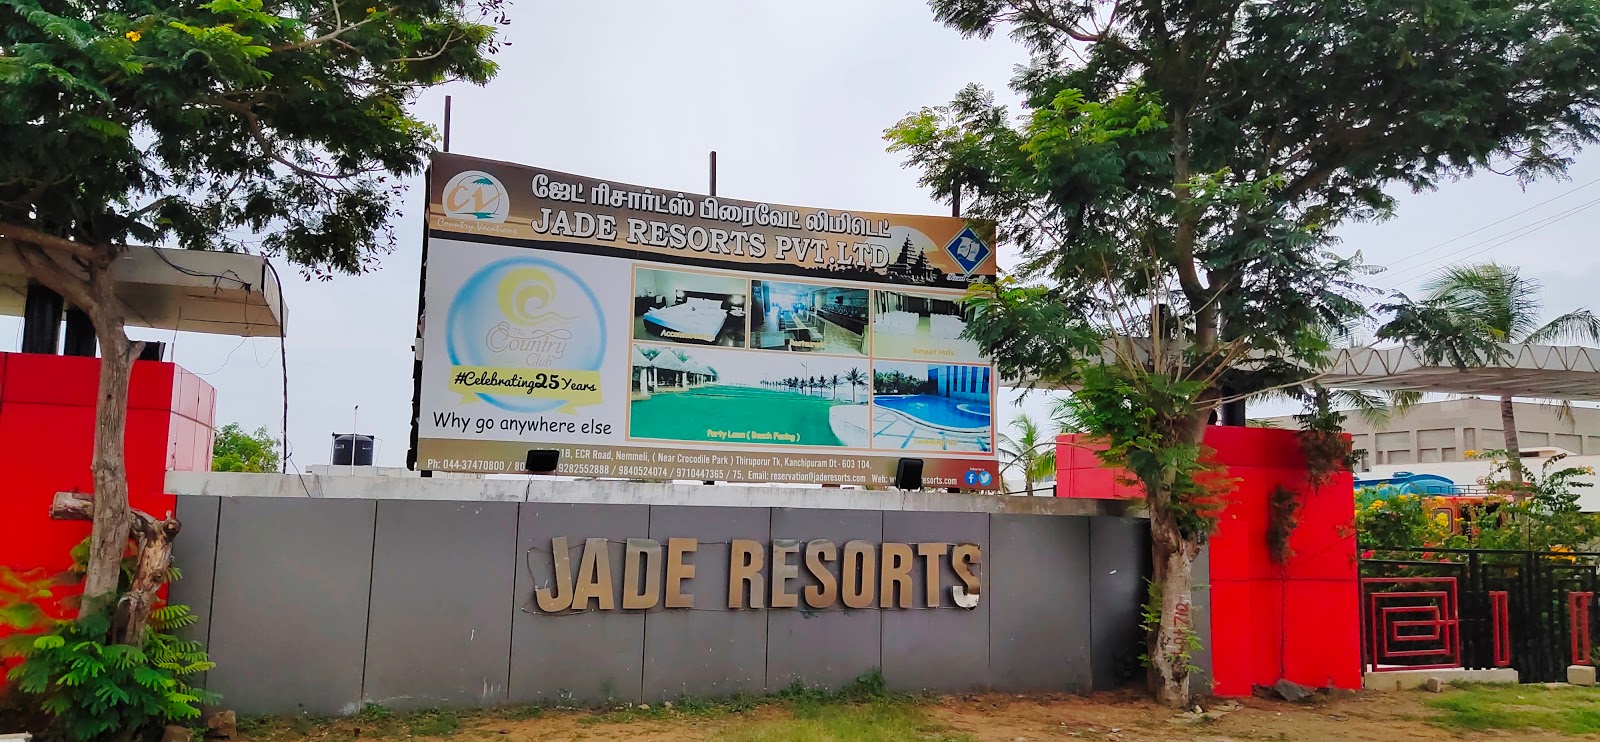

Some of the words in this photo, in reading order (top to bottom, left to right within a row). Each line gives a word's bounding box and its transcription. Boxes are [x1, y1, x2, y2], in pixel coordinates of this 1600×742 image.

[531, 173, 586, 203] ஜேட்
[591, 182, 695, 217] ரிசார்ட்ஸ்
[700, 197, 801, 229] பிரைவேட்
[805, 210, 892, 238] லிமிடெட்
[437, 217, 473, 233] Country
[476, 221, 518, 235] Vacations
[531, 208, 617, 242] JADE
[626, 217, 766, 259] RESORTS
[775, 235, 890, 269] PVT.LTD
[486, 321, 573, 359] Country
[912, 347, 937, 356] Banquet
[938, 348, 955, 356] Halls
[526, 353, 552, 367] Club
[561, 378, 597, 392] Years
[433, 411, 471, 433] Why
[476, 417, 495, 434] go
[500, 416, 576, 436] anywhere
[581, 418, 612, 435] else
[427, 458, 441, 469] Ph:
[443, 459, 505, 471] 044-37470800
[558, 463, 610, 475] 9282552888
[618, 465, 668, 477] 9840524074
[676, 468, 724, 479] 9710447365
[732, 469, 744, 480] 75,
[748, 470, 769, 480] Email:
[770, 472, 866, 483] reservation@jaderesorts.com
[871, 473, 888, 483] Web:
[575, 450, 591, 459] ECR
[593, 450, 614, 461] Road,
[616, 451, 650, 462] Nemmeli,
[658, 452, 676, 463] Near
[677, 453, 710, 464] Crocodile
[712, 454, 729, 465] Park
[735, 455, 771, 467] Thiruporur
[784, 457, 827, 469] Kanchipuram
[841, 459, 855, 469] 603
[535, 536, 698, 613] JADE
[728, 538, 982, 611] RESORTS
